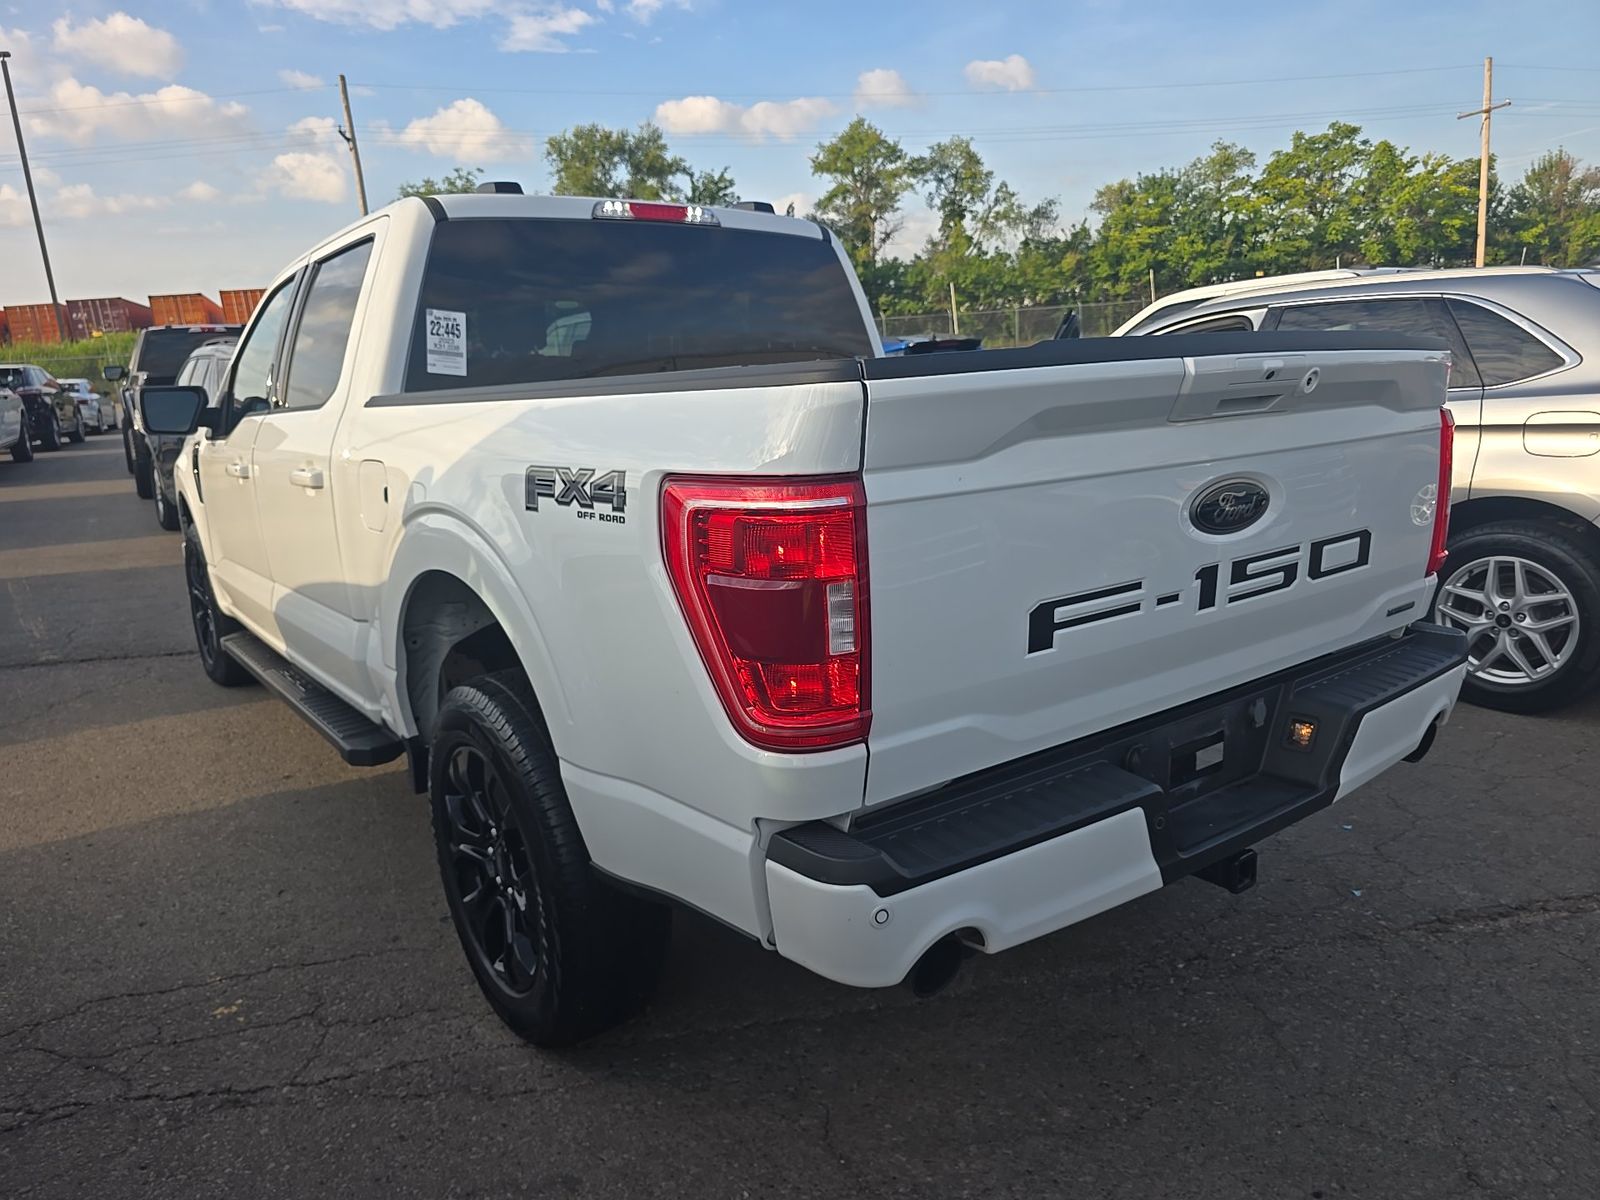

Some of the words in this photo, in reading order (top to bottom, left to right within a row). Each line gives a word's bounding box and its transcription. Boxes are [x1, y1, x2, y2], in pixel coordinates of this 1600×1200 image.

[525, 465, 626, 513] FX4
[1214, 491, 1258, 523] Ford
[577, 511, 595, 520] OFF
[599, 513, 625, 524] ROAD
[1027, 529, 1372, 655] F-150
